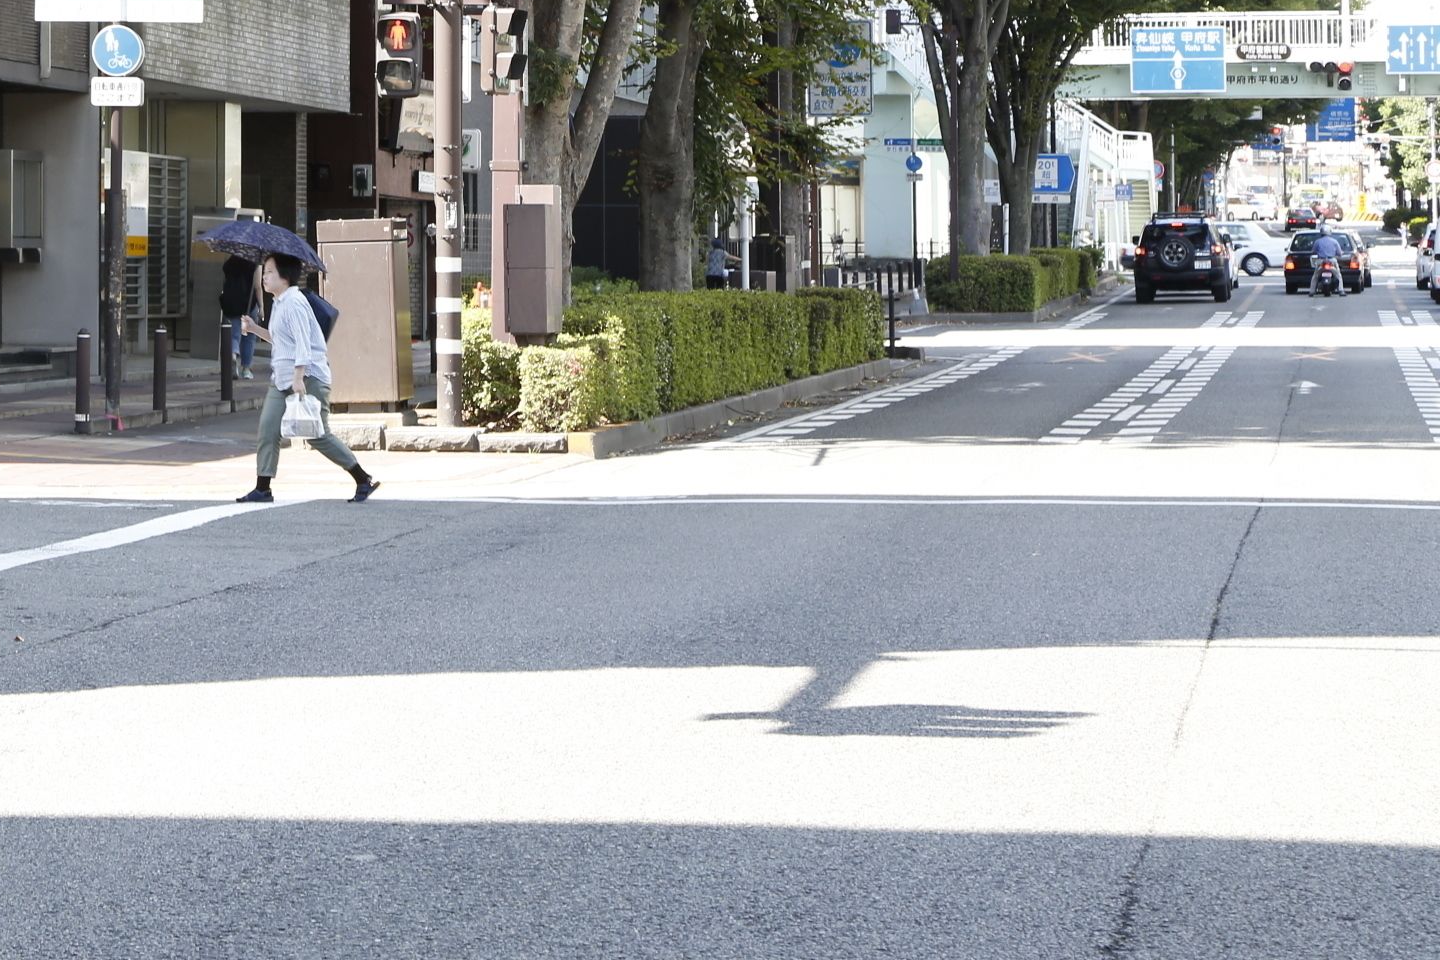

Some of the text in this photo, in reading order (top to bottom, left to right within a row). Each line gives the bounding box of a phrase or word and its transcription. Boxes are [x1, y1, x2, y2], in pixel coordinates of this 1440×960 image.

[1227, 74, 1298, 85] 甲府市平和通り
